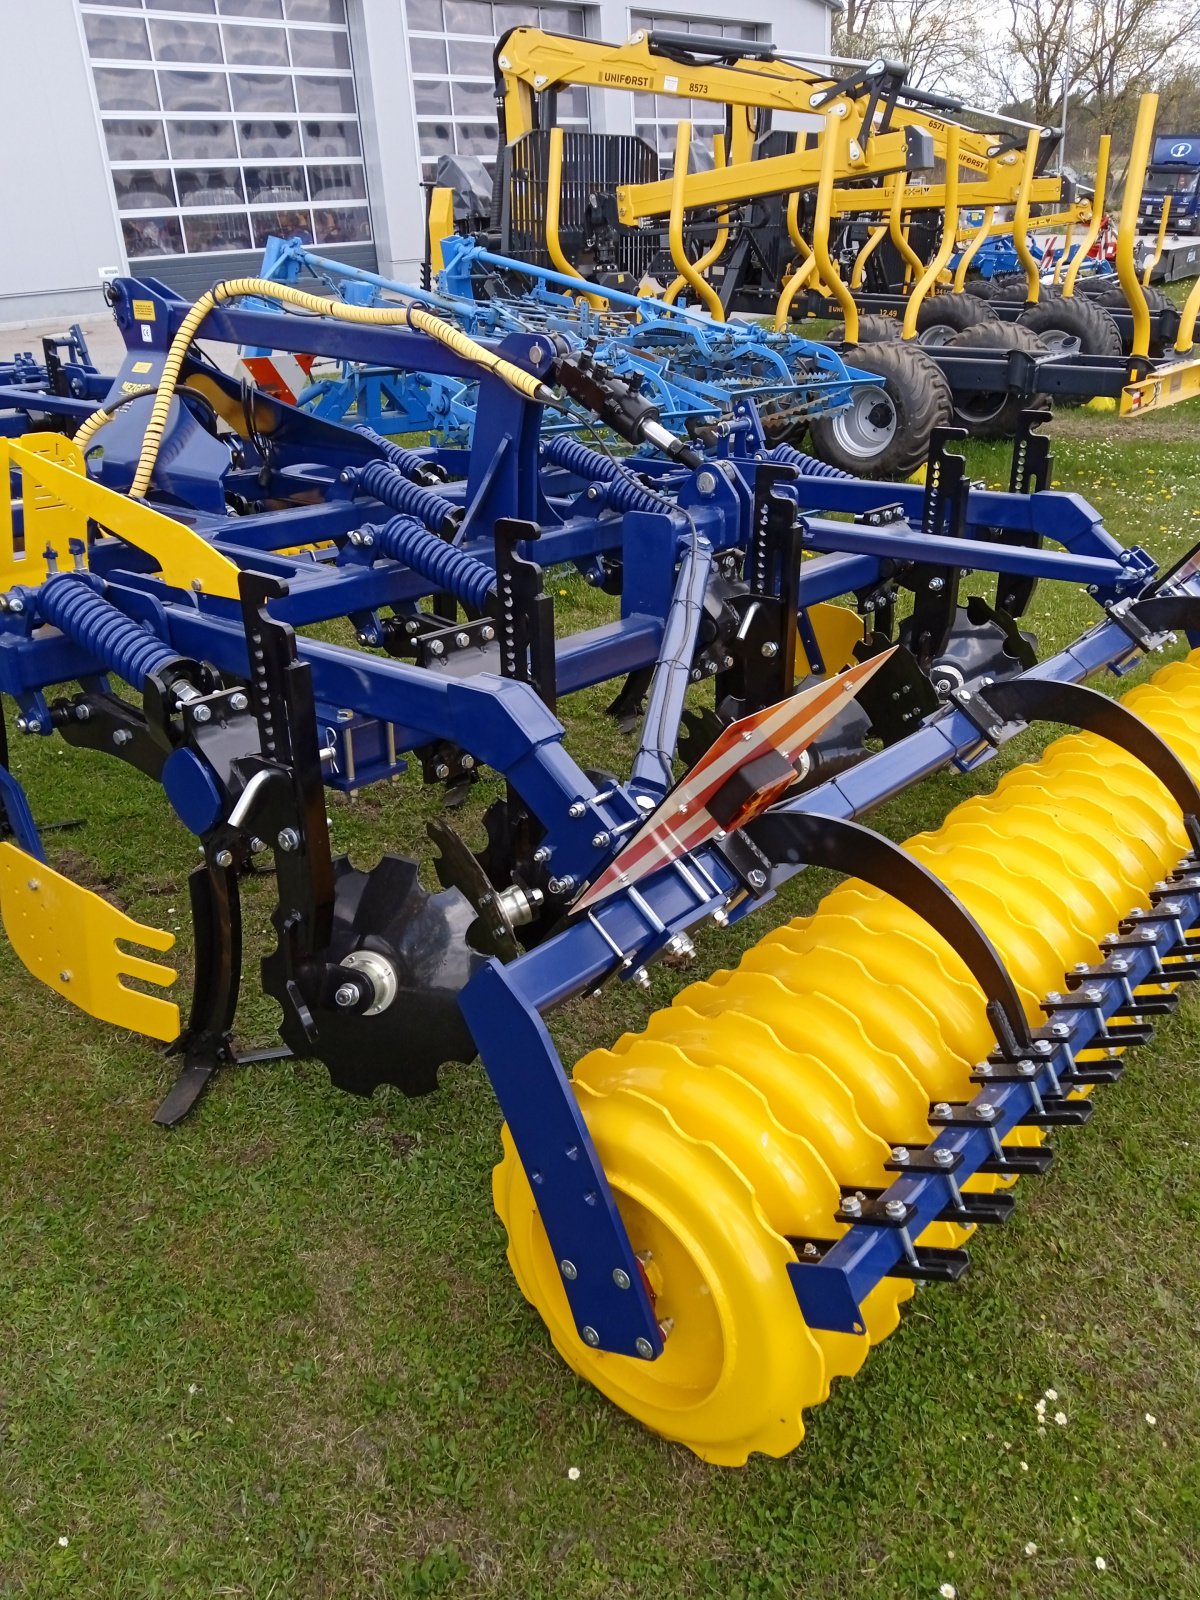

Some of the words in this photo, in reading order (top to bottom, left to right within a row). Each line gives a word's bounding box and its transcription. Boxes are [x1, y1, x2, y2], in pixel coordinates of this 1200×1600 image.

[604, 72, 649, 87] UNIFORST
[688, 83, 708, 94] 8573
[928, 120, 945, 132] 6571
[879, 308, 897, 318] 12.49
